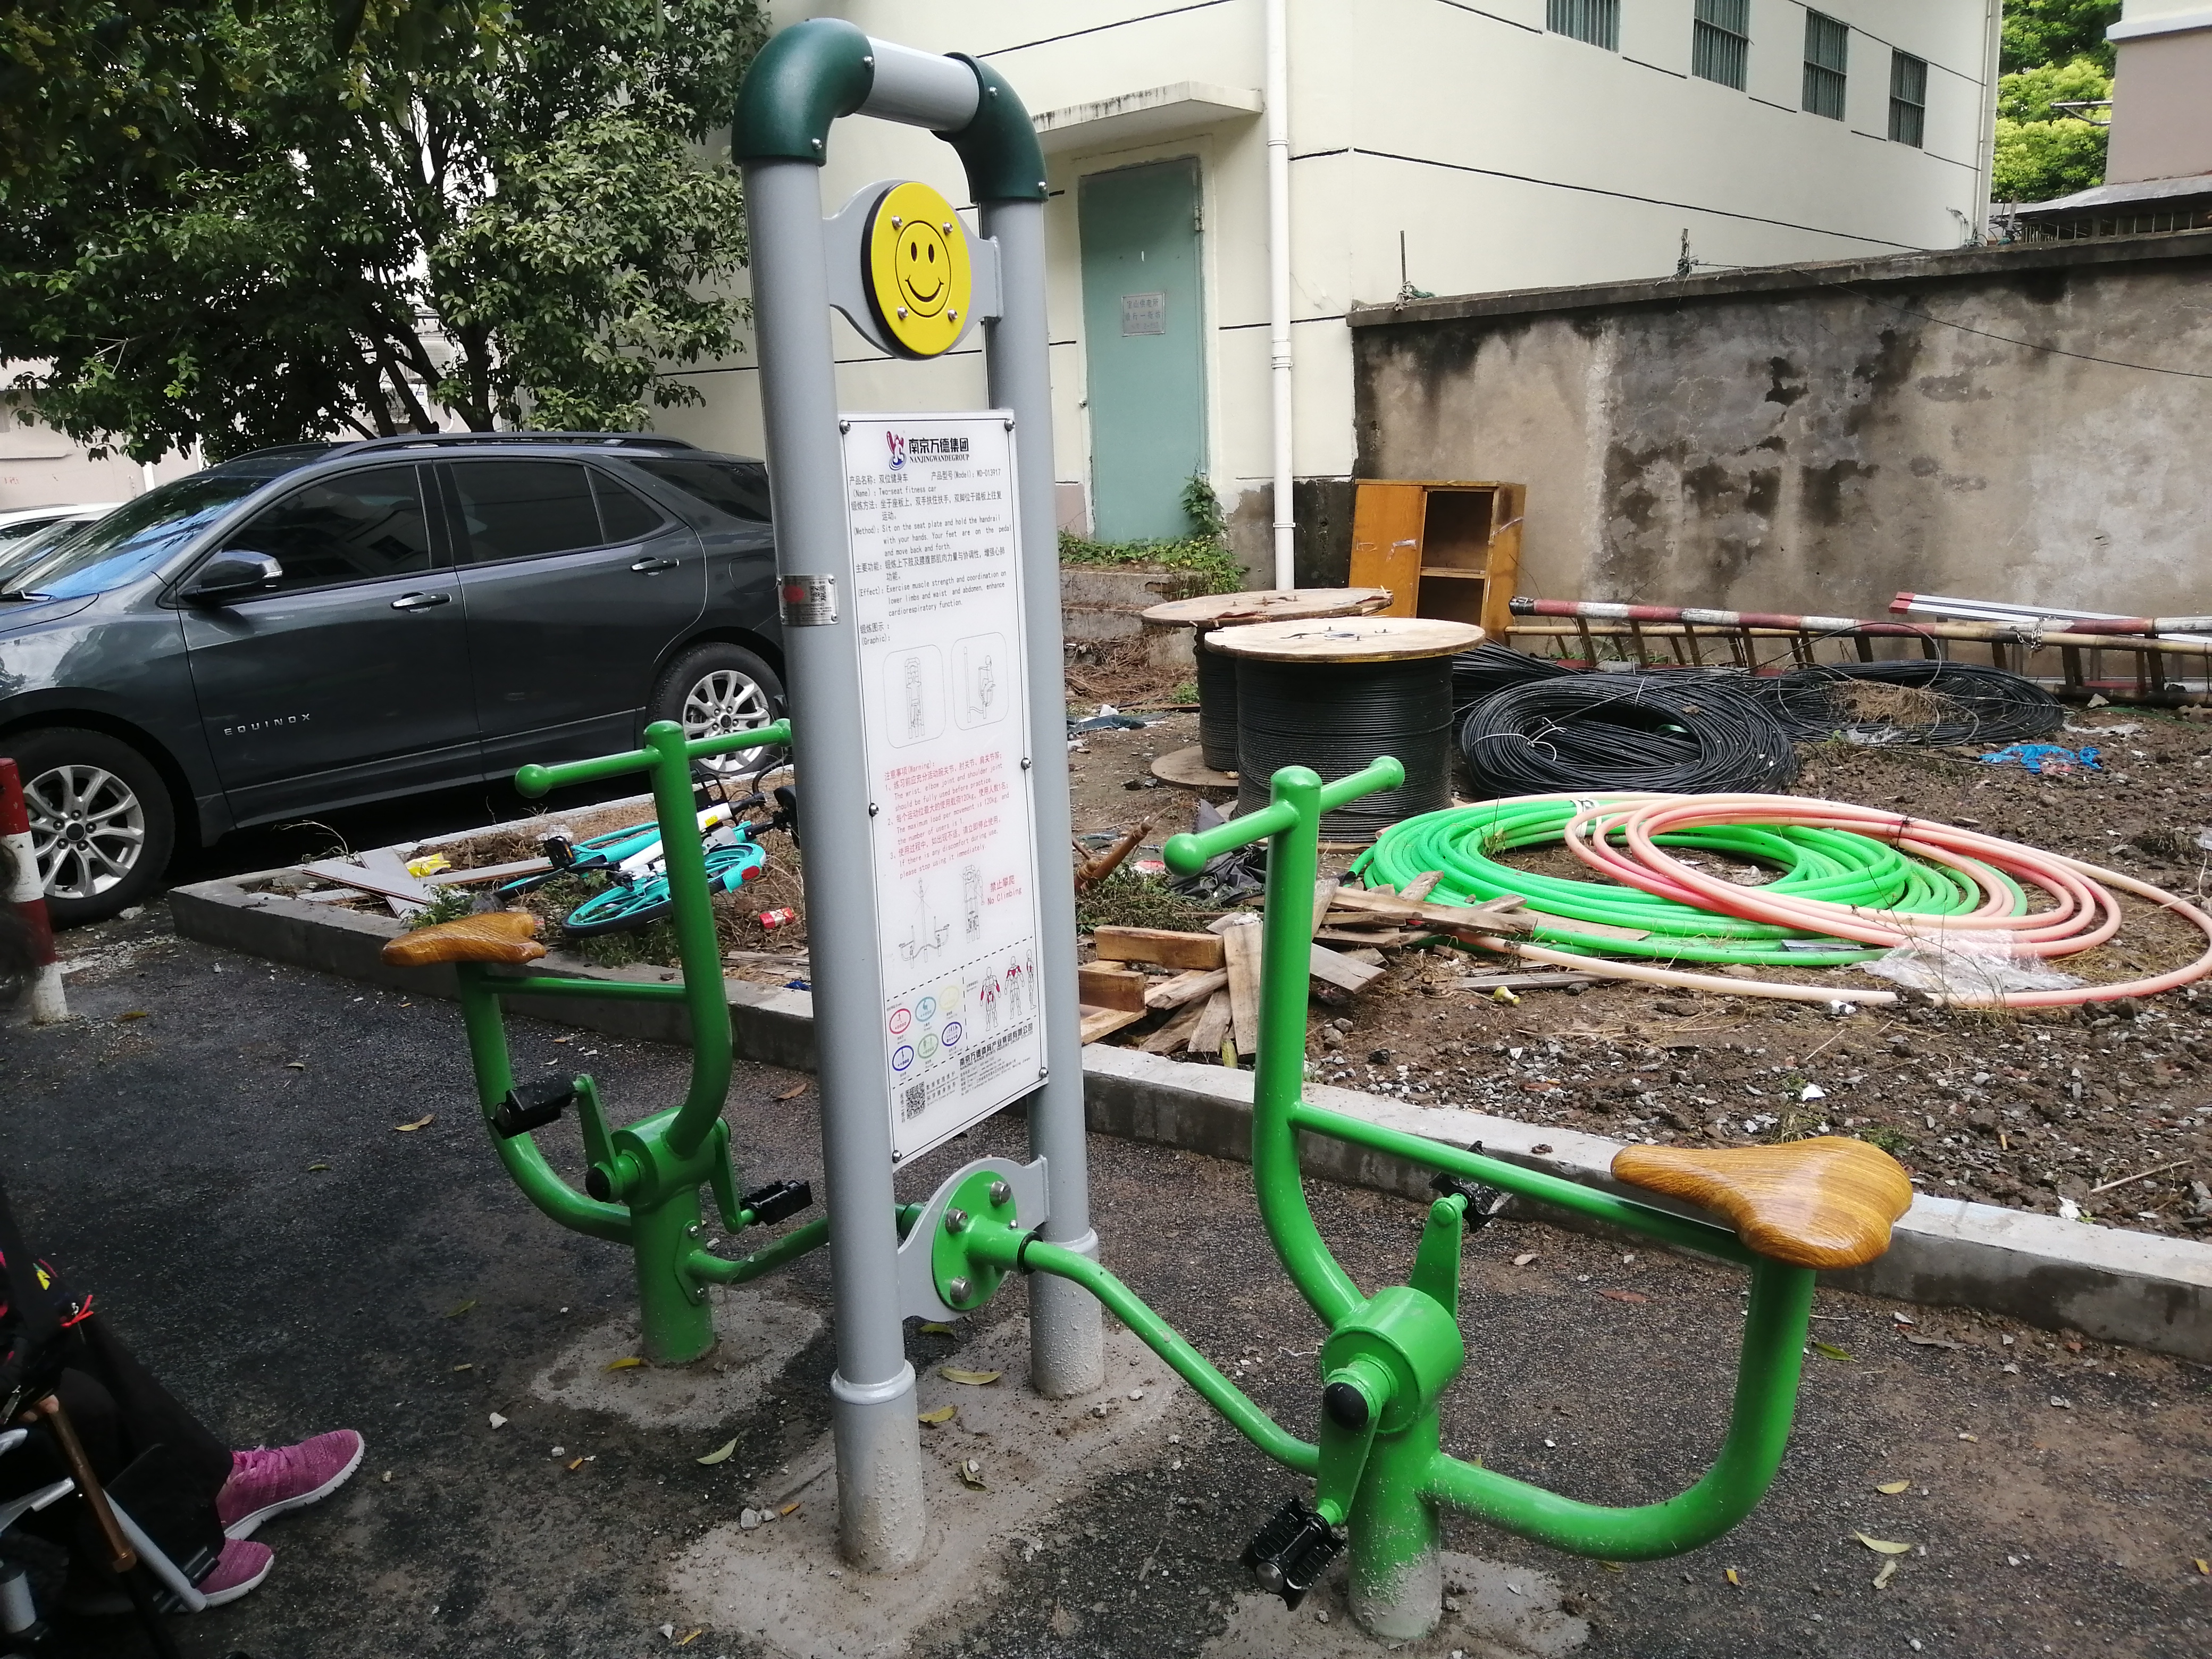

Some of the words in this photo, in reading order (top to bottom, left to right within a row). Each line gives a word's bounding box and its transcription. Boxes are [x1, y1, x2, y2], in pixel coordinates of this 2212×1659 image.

[909, 438, 969, 454] 南京万德集团
[910, 454, 969, 463] NANJINGWANDEGROUP
[979, 514, 1000, 523] handrail
[999, 524, 1011, 533] pedal
[886, 584, 910, 592] Exercise
[932, 577, 954, 586] strength
[967, 572, 999, 581] coordination
[889, 604, 937, 616] cardiorespiratory
[224, 714, 310, 735] EQUINOX
[991, 875, 1015, 892] 禁止攀爬
[988, 897, 994, 906] No
[997, 888, 1021, 901] Climbing
